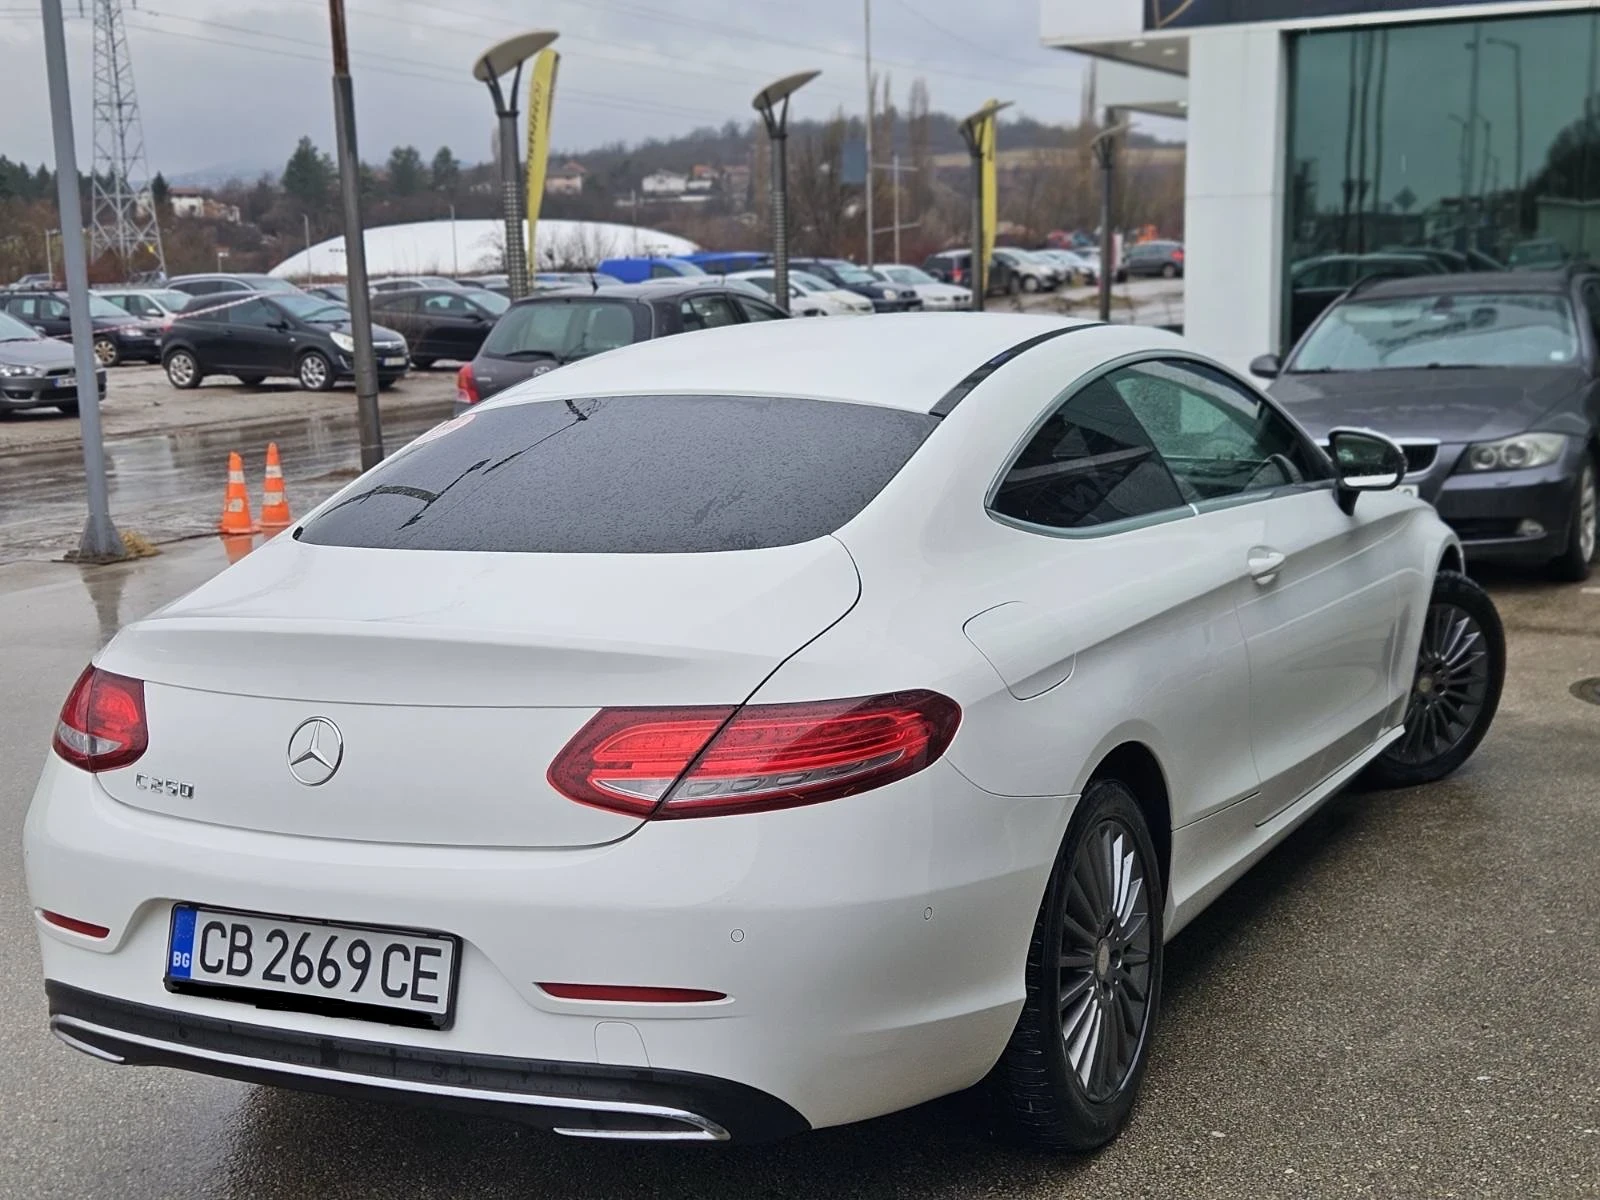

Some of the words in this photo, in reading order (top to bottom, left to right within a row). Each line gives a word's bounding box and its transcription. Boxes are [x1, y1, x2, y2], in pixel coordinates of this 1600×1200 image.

[172, 951, 190, 968] BG
[200, 920, 253, 977] CB
[262, 928, 371, 993] 2669
[381, 943, 442, 1004] CE
